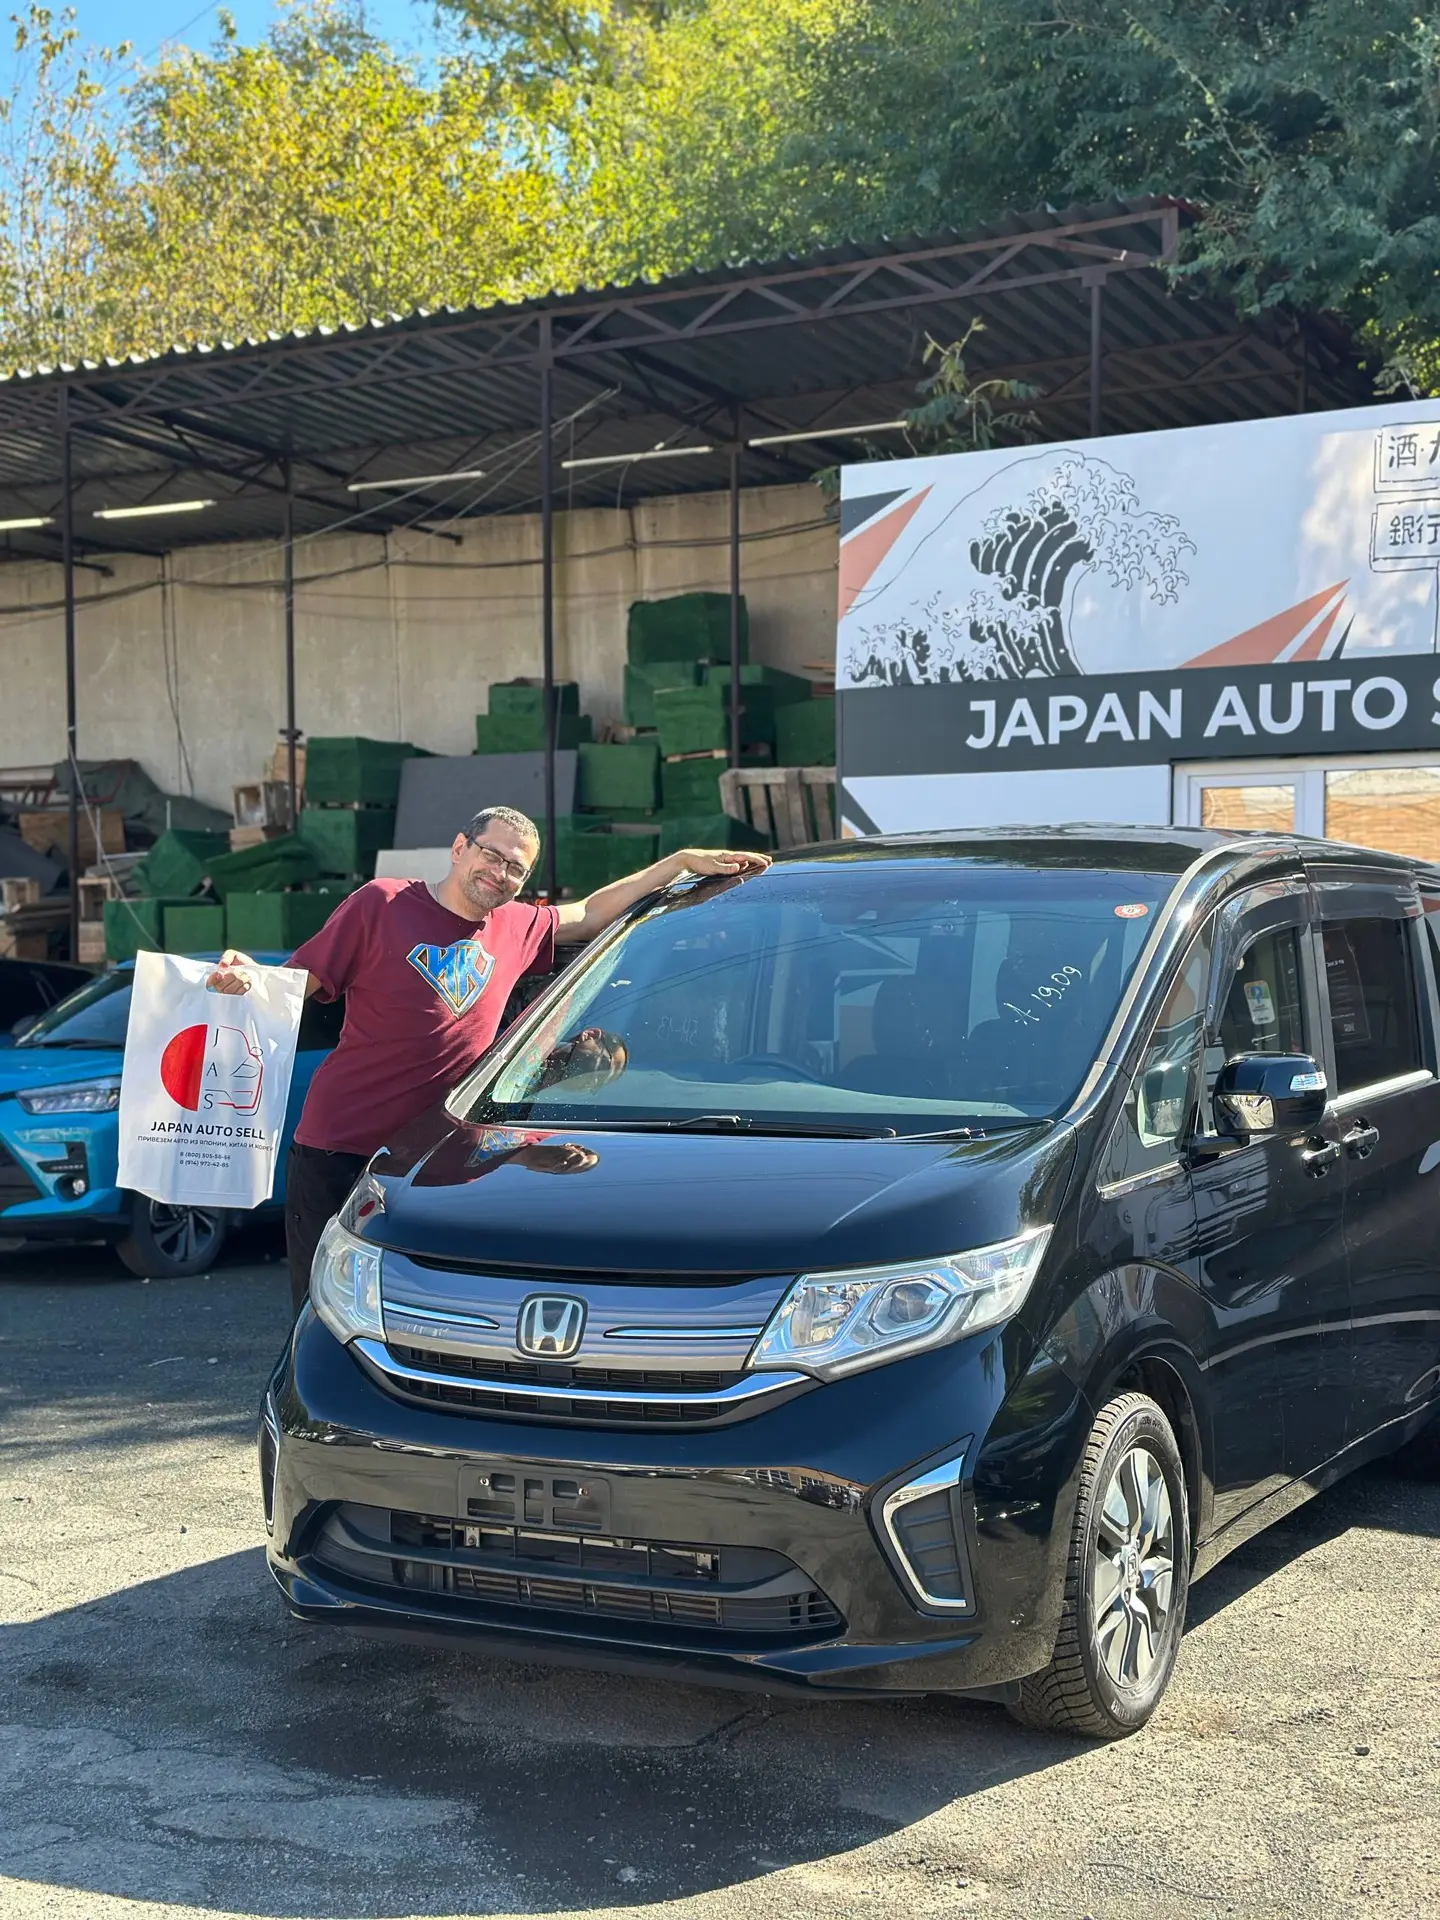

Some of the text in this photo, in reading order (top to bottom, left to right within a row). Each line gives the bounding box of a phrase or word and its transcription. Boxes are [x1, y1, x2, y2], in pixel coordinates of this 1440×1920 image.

[966, 688, 1183, 750] JAPAN
[1203, 676, 1408, 737] AUTO
[137, 1135, 172, 1144] ПРИВЕЗЕМ
[150, 1121, 266, 1140] JAPAN AUTO SELL
